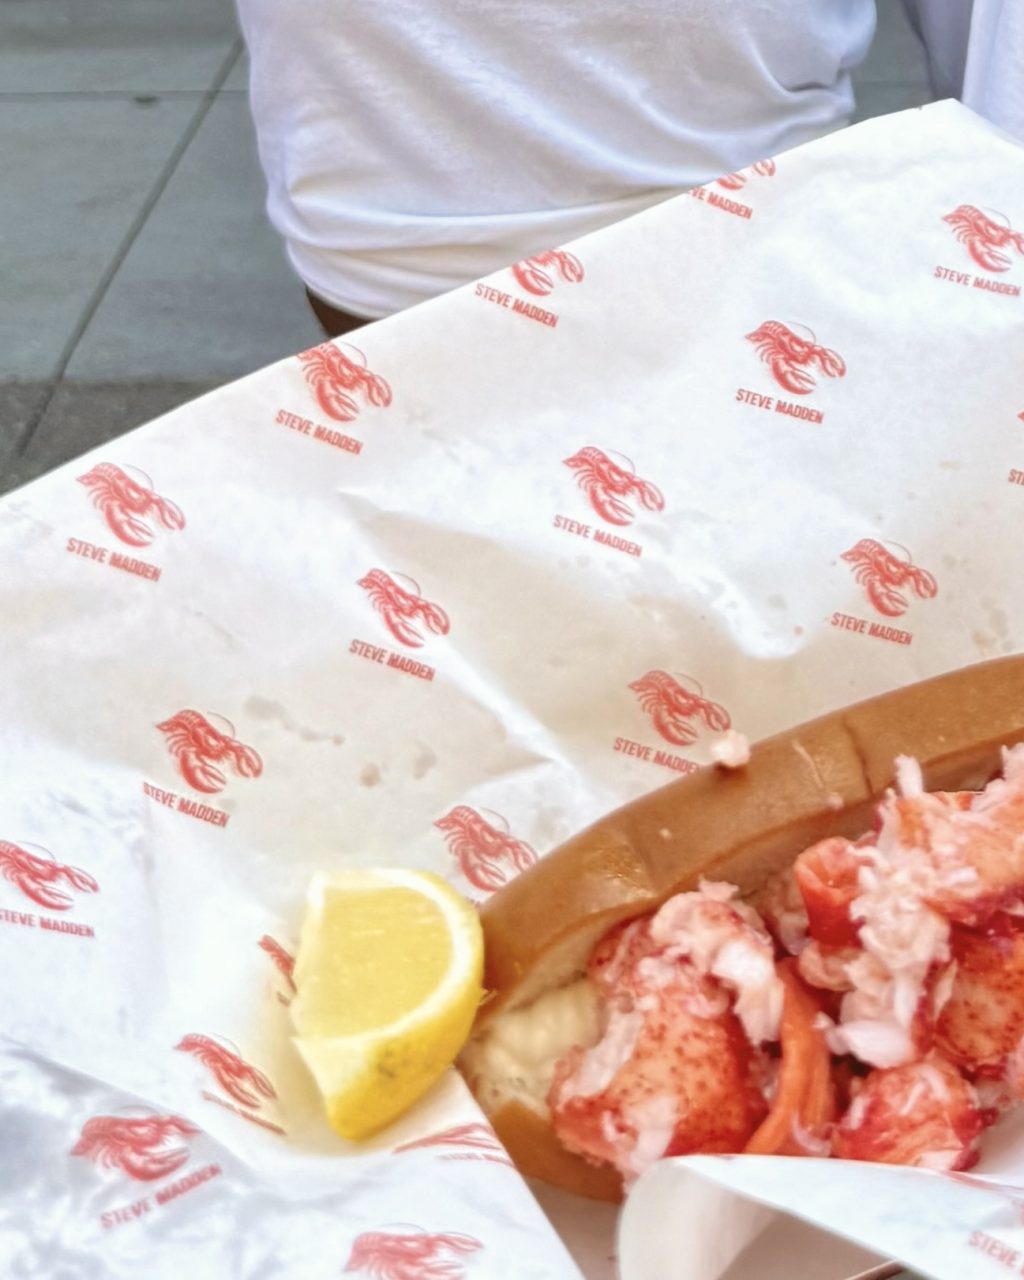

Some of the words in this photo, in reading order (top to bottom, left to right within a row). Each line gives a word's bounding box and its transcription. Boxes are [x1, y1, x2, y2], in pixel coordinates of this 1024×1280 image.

[707, 191, 752, 219] MADDEN
[934, 265, 971, 285] STEVE
[973, 277, 1021, 296] MADDEN
[475, 283, 512, 308] STEVE
[512, 298, 559, 327] MADDEN
[736, 388, 773, 410] STEVE
[775, 399, 824, 424] MADDEN
[276, 410, 314, 435] STEVE
[313, 424, 363, 455] MADDEN
[553, 515, 592, 539] STEVE
[593, 529, 642, 558] MADDEN
[66, 537, 109, 564] STEVE
[109, 552, 161, 582] MADDEN
[831, 612, 867, 634] STEVE
[868, 623, 912, 646] MADDEN
[349, 639, 387, 664] STEVE
[387, 653, 435, 681] MADDEN
[613, 737, 652, 761] STEVE
[653, 751, 699, 774] MADDE
[143, 782, 177, 808] STEVE
[177, 797, 230, 828] MADDEN
[39, 916, 95, 938] MADDEN
[100, 1196, 152, 1230] STEVE
[154, 1163, 223, 1206] MADDEN
[968, 1230, 1021, 1268] STEVE
